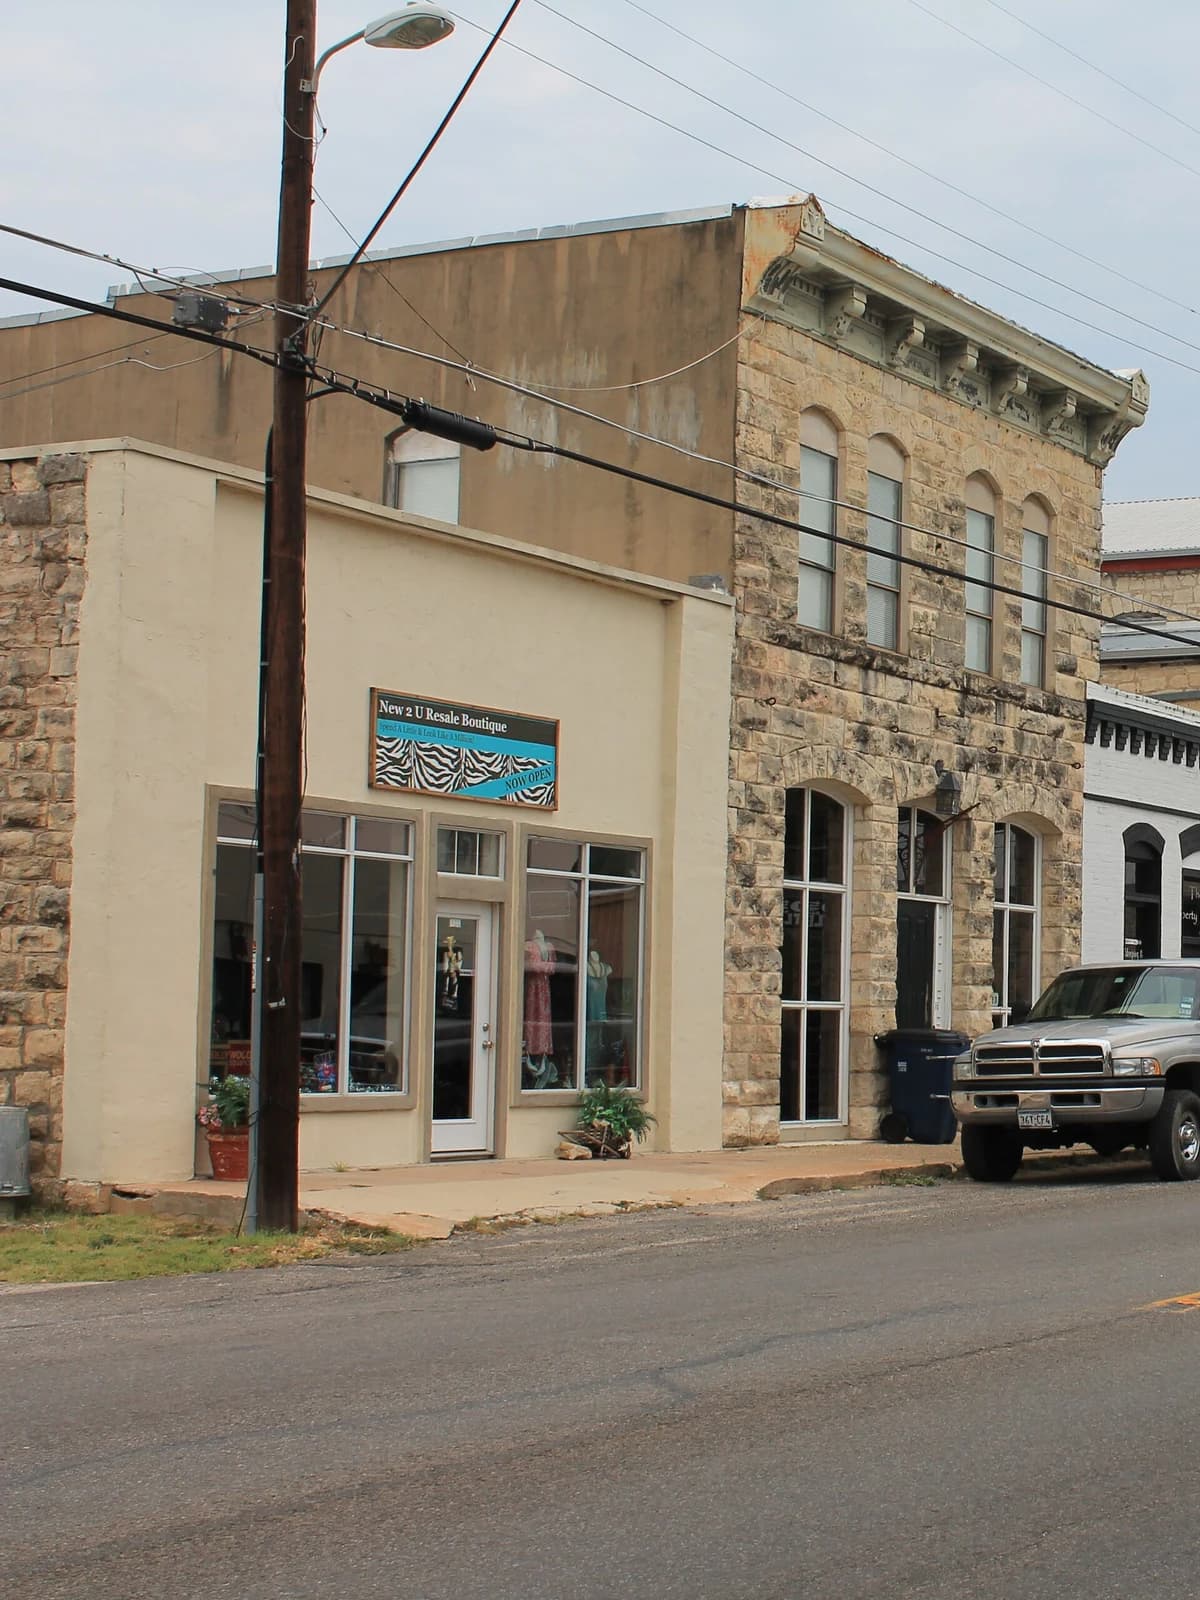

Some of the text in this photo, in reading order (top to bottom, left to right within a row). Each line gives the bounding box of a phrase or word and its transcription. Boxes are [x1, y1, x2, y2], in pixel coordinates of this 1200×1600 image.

[379, 699, 508, 734] New 2 U Resale Boutique
[505, 767, 552, 791] NOW OPEN
